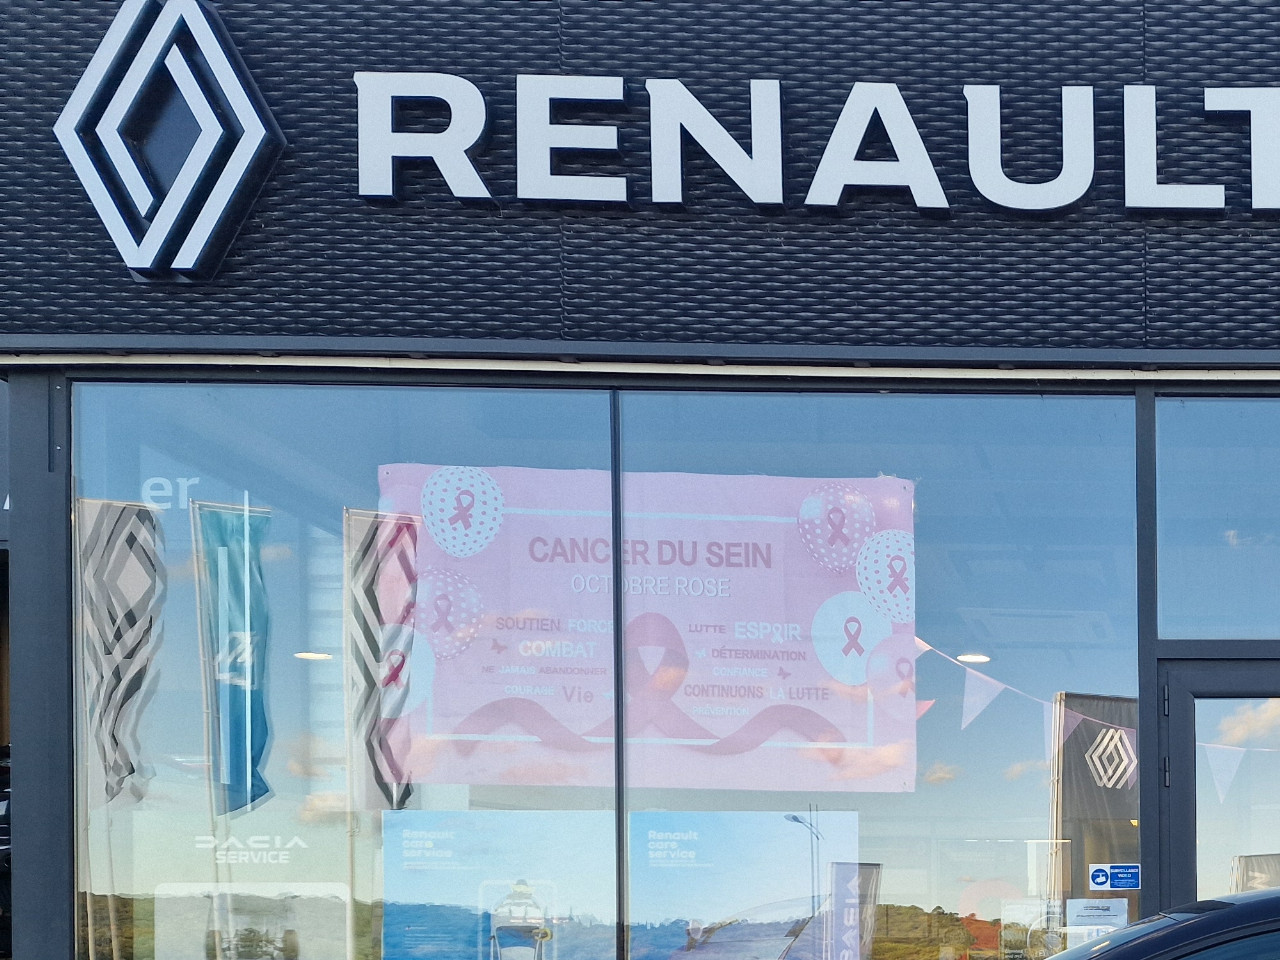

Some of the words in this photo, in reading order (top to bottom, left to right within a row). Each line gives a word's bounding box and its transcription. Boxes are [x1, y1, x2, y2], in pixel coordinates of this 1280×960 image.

[657, 539, 698, 567] DU
[705, 541, 772, 569] SEIN
[675, 576, 731, 598] ROSE
[495, 616, 561, 632] SOUTIEN
[688, 623, 727, 635] LUTTE
[518, 640, 597, 658] COMBAT
[711, 645, 807, 662] DÉTERMINATION
[538, 666, 608, 676] ABANDONNER
[712, 667, 769, 678] CONFIANCE
[561, 685, 595, 704] Vie
[684, 684, 764, 699] CONTINUONS
[788, 687, 830, 700] LUTTE
[194, 835, 309, 849] DACIA
[648, 830, 699, 841] Renault
[648, 841, 680, 850] care
[215, 851, 290, 864] SERVICE
[648, 849, 696, 859] service
